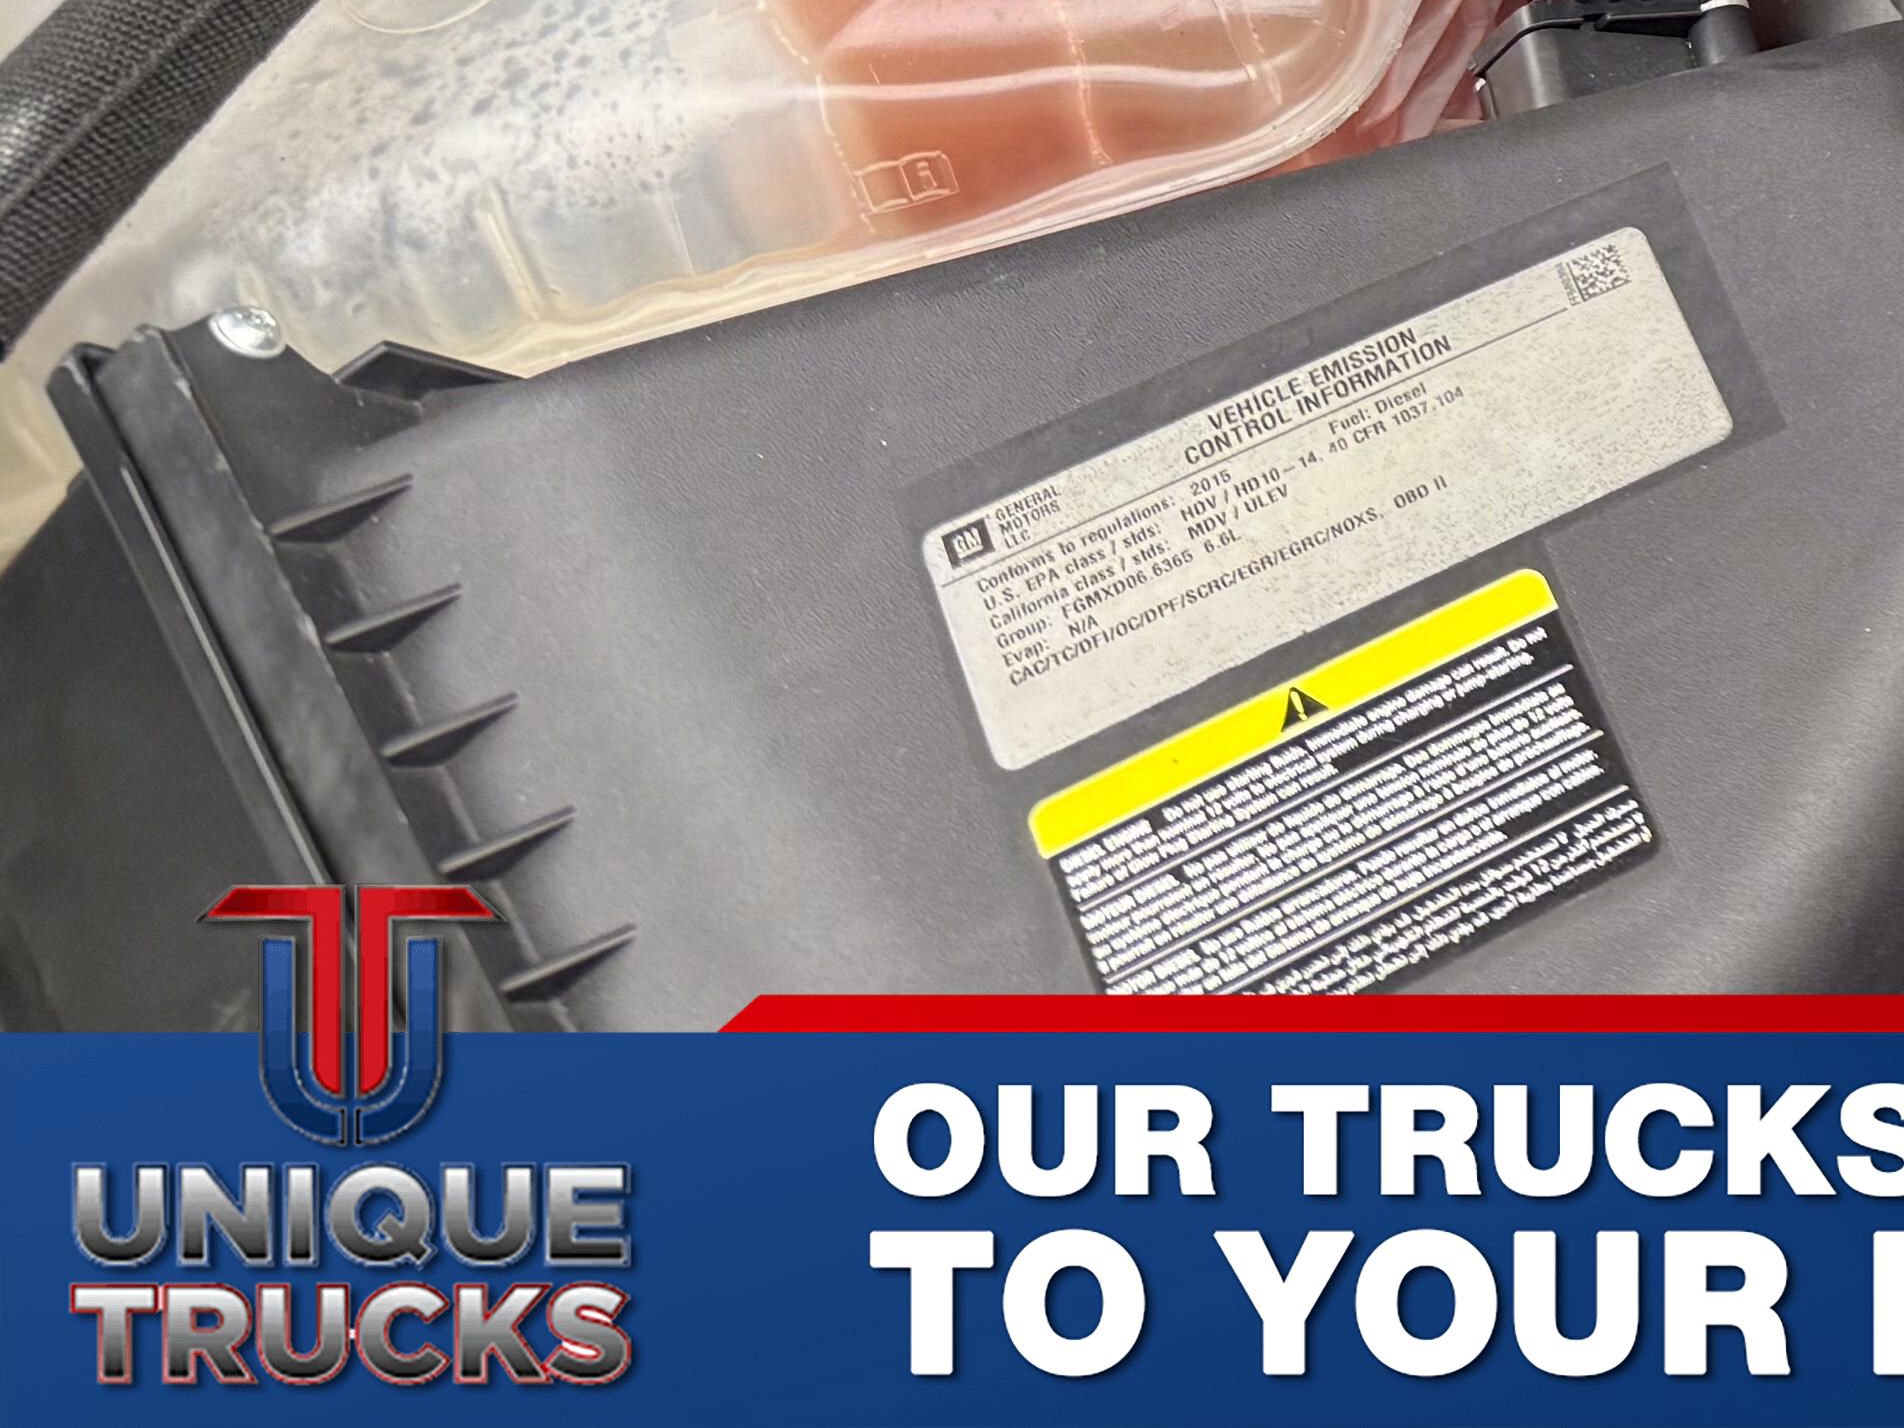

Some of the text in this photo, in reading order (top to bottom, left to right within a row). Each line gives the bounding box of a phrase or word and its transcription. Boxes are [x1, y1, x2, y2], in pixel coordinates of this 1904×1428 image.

[1182, 333, 1452, 466] CONTROL INFORMATION
[1207, 325, 1418, 432] VEHICLE EMISSION
[975, 381, 1427, 593] Conforms to regulations: 2015 Fuel: Diesel
[993, 483, 1061, 522] GENERAL
[1391, 482, 1430, 510] OBD
[998, 499, 1061, 536] MOTORS
[1003, 528, 1031, 549] LLC
[982, 585, 1021, 611] U.S.
[1024, 565, 1061, 592] EPA
[1062, 545, 1107, 575] class
[988, 584, 1070, 631] California
[1072, 563, 1116, 592] class
[1186, 511, 1229, 540] MDV
[1243, 483, 1291, 514] ULEV
[995, 614, 1054, 650] Group:
[1002, 614, 1099, 669] Evap: N/A
